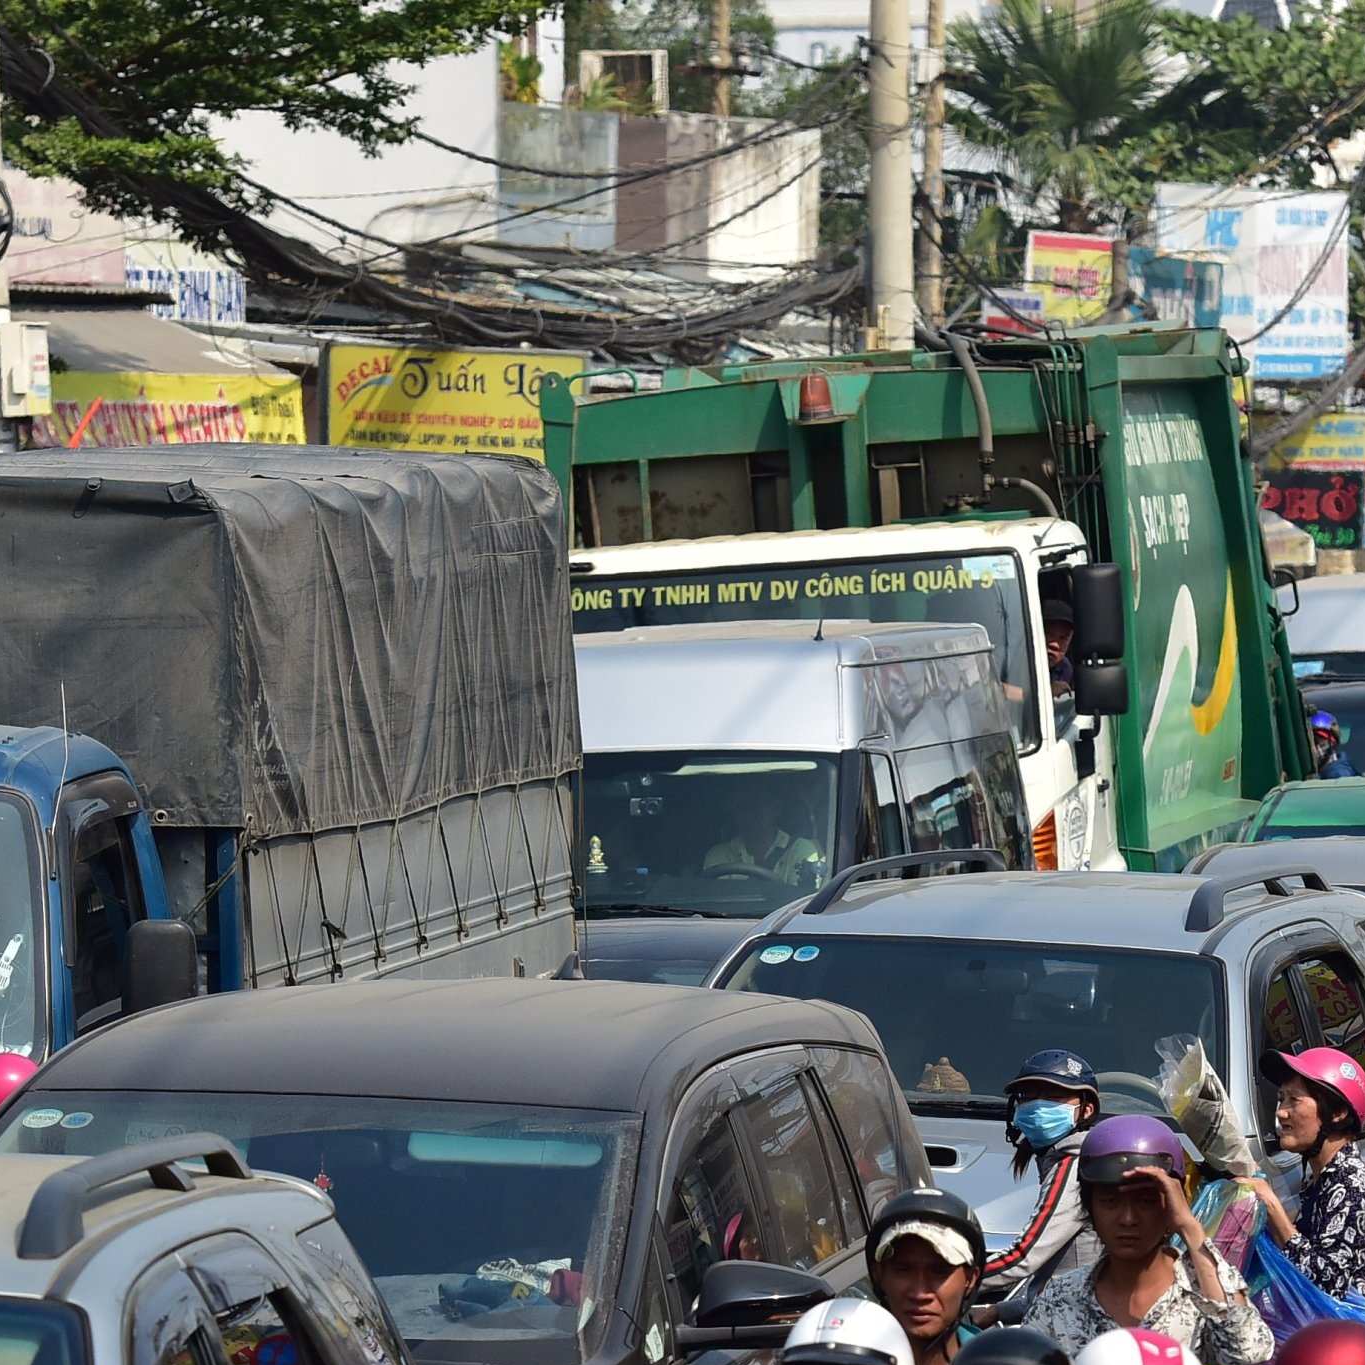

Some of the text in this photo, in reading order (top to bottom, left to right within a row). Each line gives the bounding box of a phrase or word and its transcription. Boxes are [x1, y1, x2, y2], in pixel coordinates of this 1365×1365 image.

[336, 355, 392, 402] DECAL
[401, 357, 486, 400] Tuấn
[1262, 475, 1358, 522] PHỞ
[572, 570, 995, 612] ÔNG TY TNHH MTV DV CÔNG ÍCH QUẬN 9
